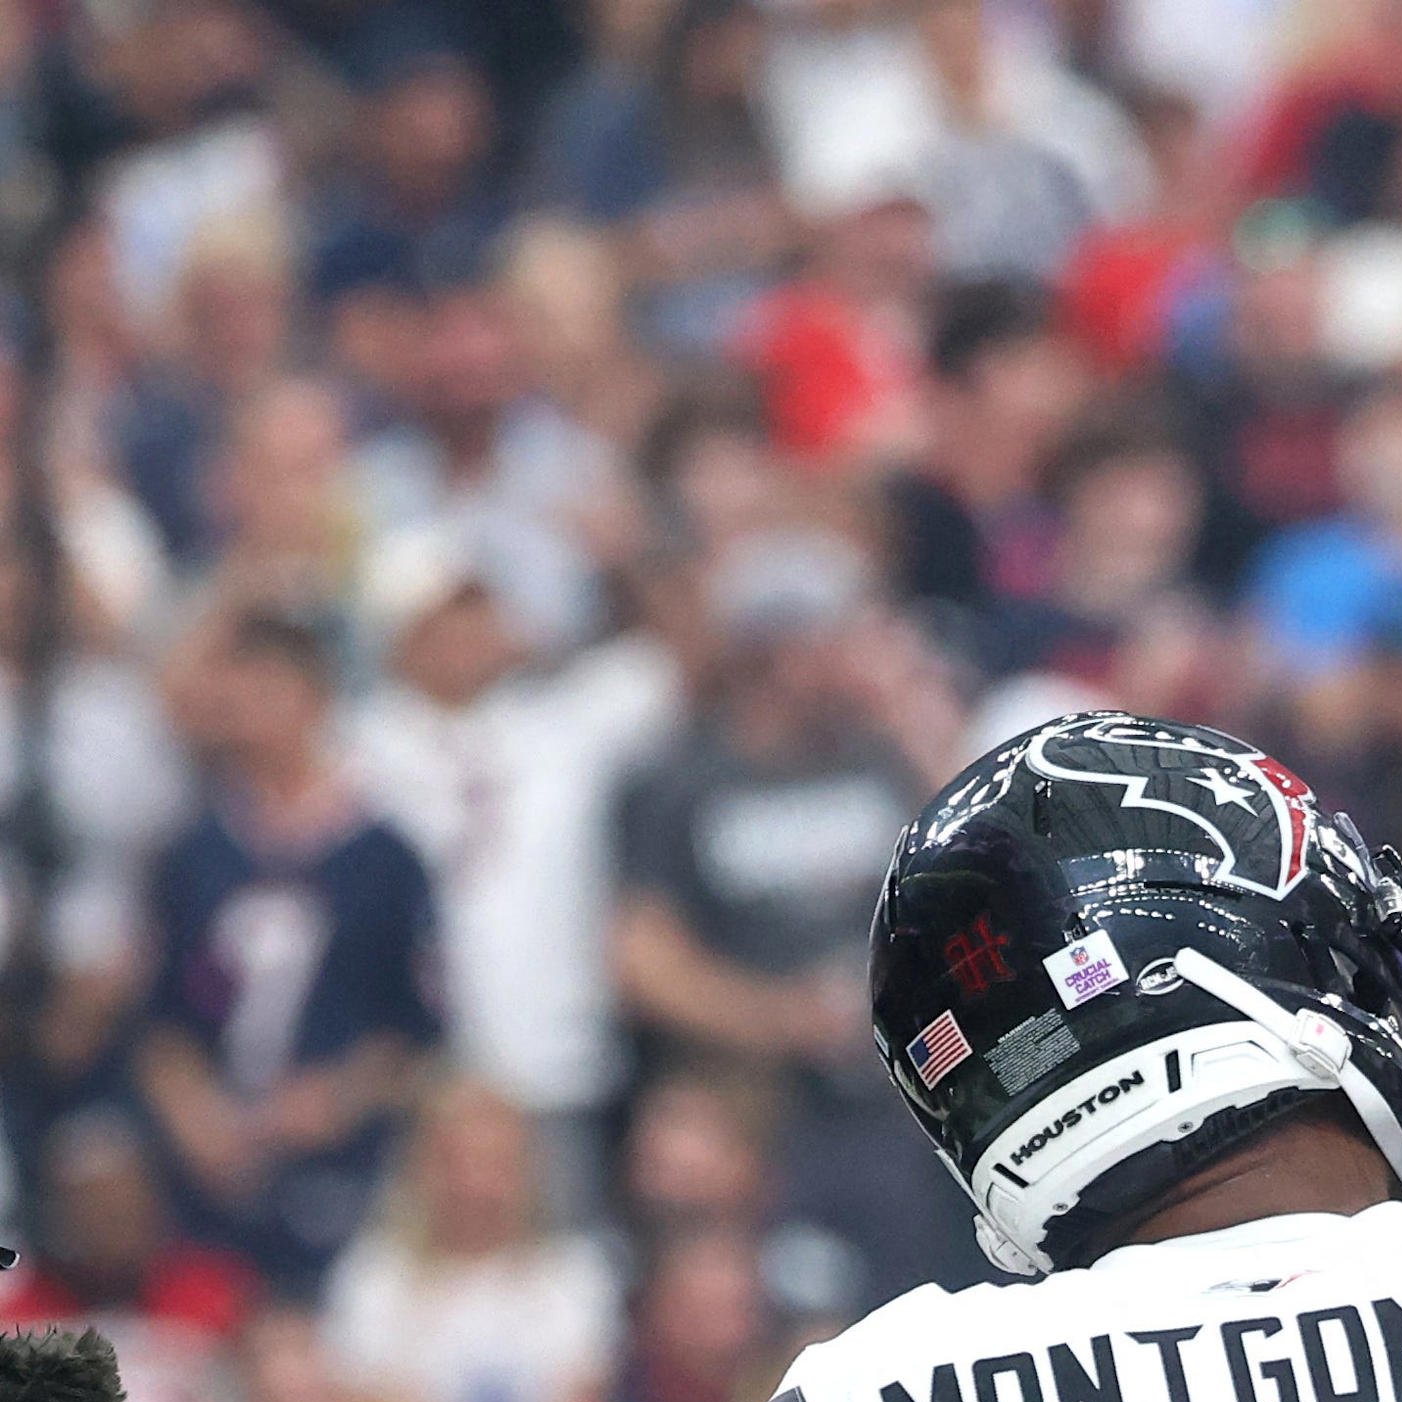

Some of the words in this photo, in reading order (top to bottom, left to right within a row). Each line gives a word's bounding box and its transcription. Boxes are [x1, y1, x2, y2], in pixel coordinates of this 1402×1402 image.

[1064, 959, 1112, 988] CRUCIAL
[1075, 970, 1111, 994] CATCH
[1010, 1070, 1145, 1166] HOUSTON
